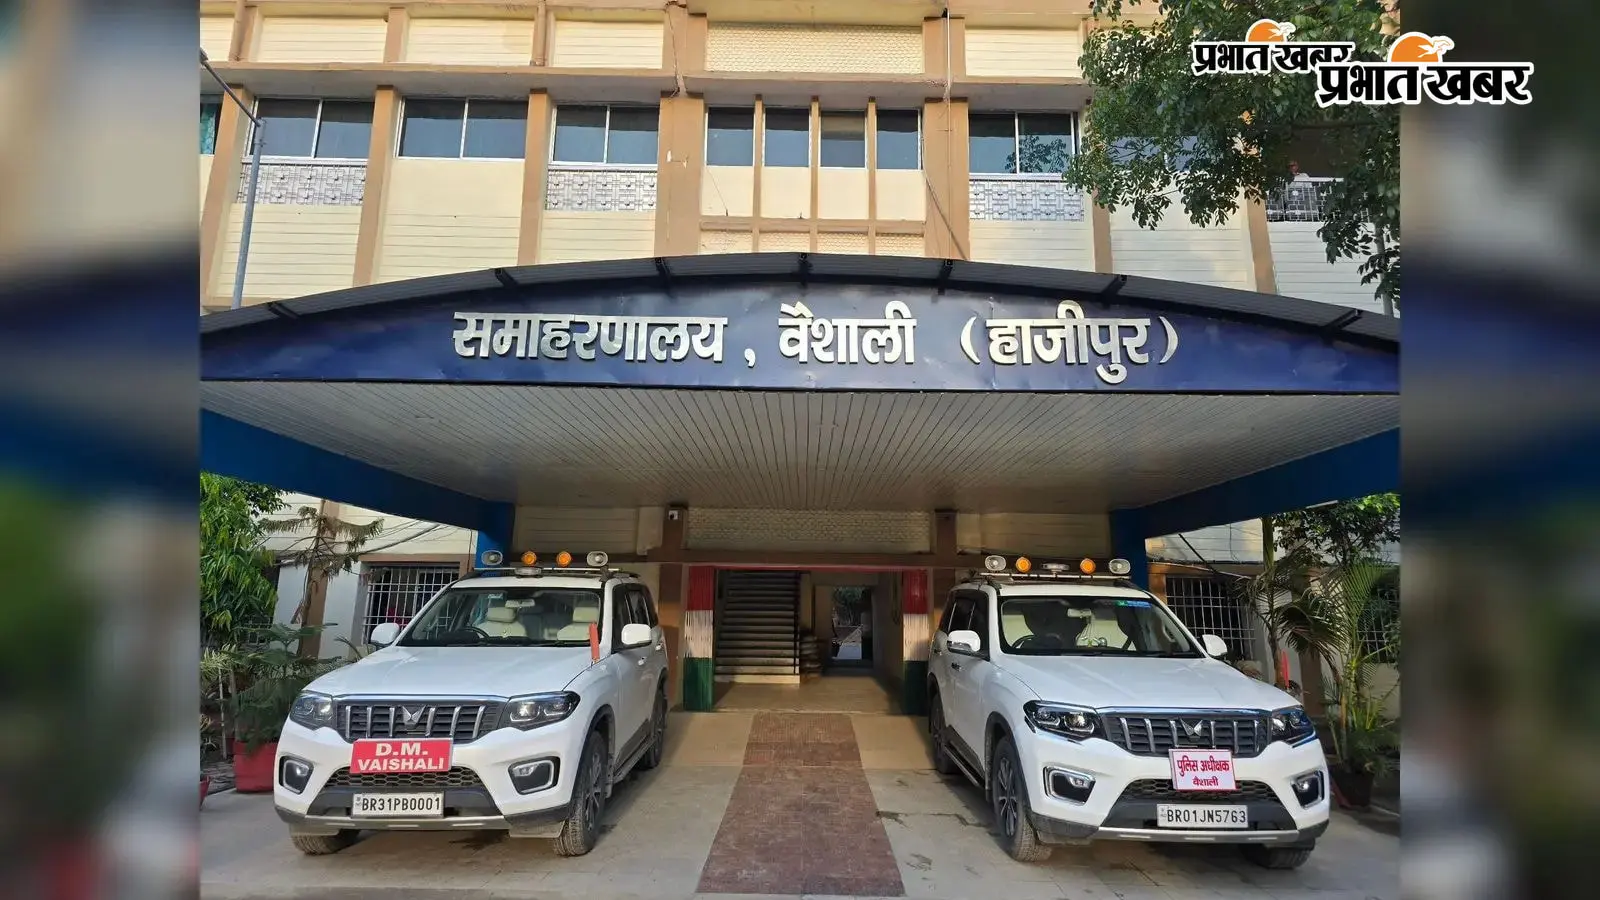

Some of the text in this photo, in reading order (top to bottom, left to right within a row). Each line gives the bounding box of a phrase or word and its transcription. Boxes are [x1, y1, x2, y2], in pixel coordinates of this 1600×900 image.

[453, 311, 728, 363] समाहरणालय
[778, 300, 917, 364] वैशाली
[376, 742, 428, 756] D.M.
[358, 758, 444, 770] VAISHALI
[1177, 755, 1230, 776] पुलिस अधीक्षक
[1192, 776, 1219, 787] वैशाली
[362, 797, 440, 811] BR31PB0001
[1167, 809, 1246, 822] BR01JN5763
